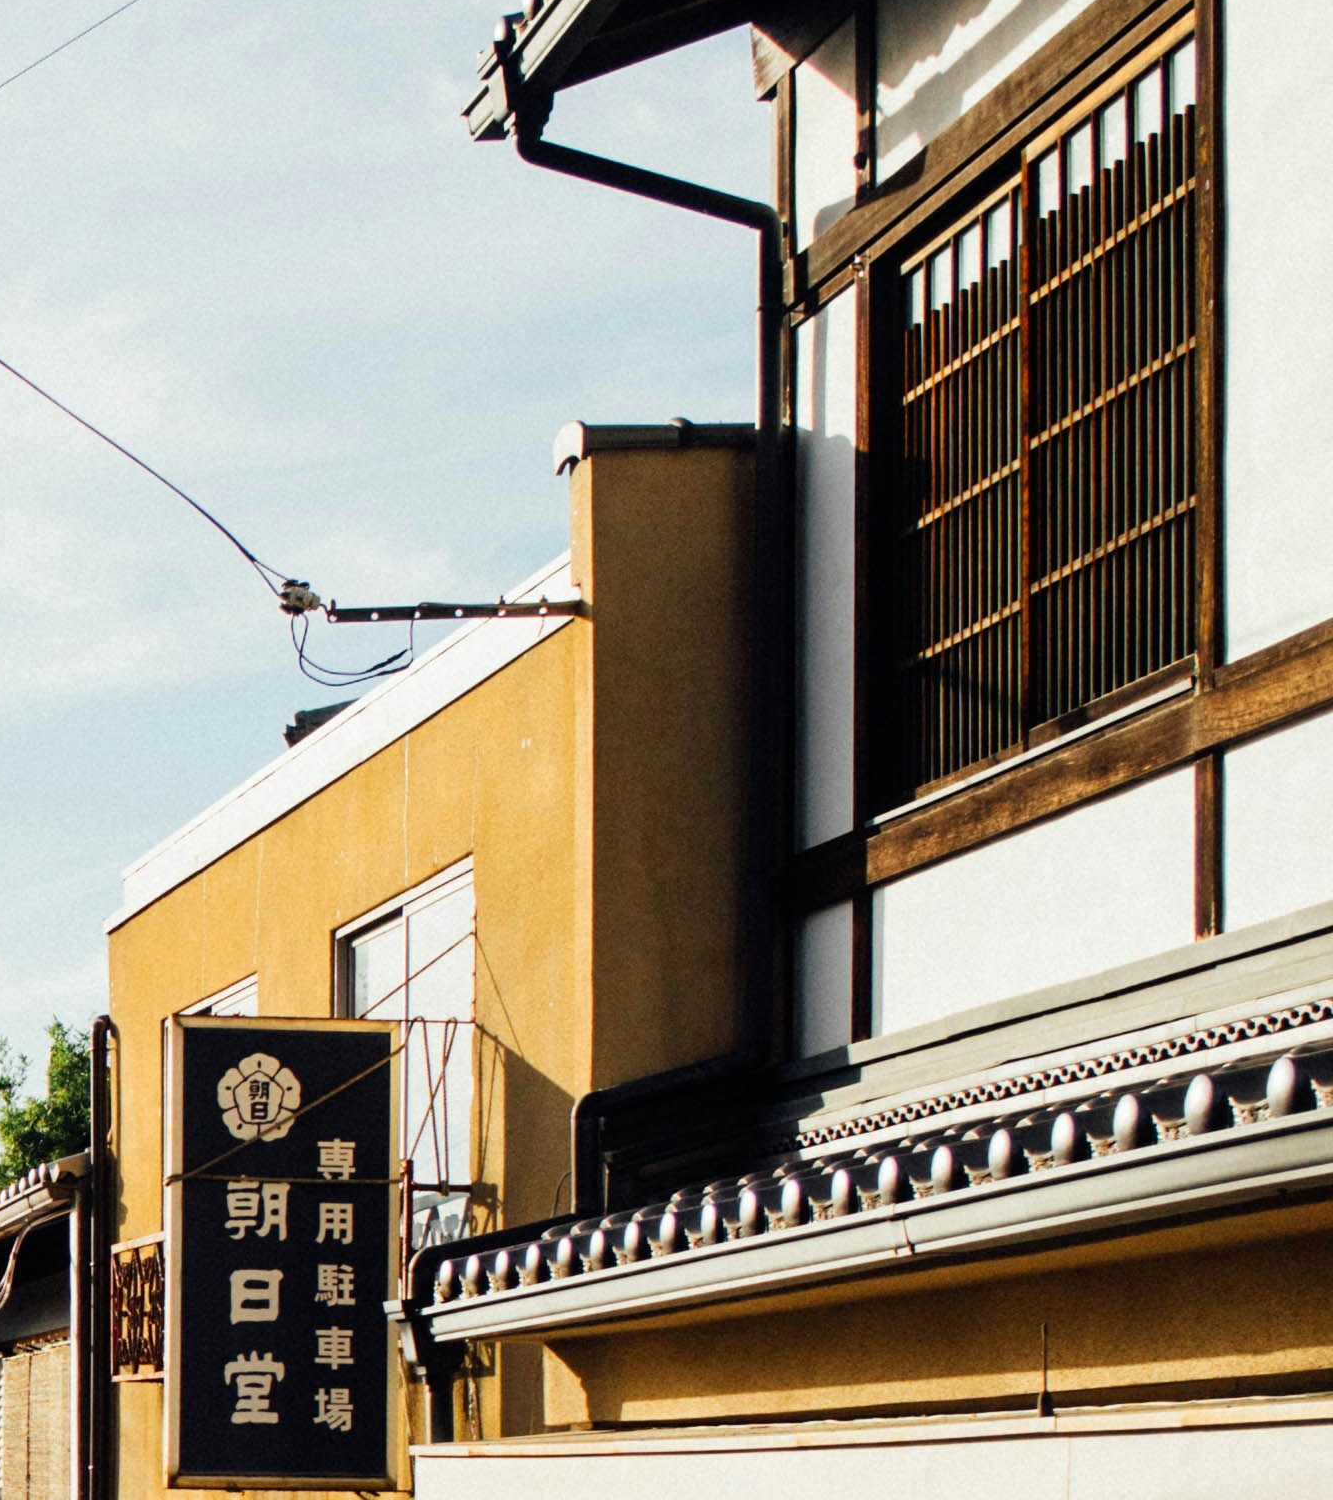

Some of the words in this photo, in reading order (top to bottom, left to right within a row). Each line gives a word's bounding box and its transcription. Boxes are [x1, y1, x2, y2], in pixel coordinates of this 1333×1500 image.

[249, 1080, 272, 1121] 朝日
[224, 1180, 290, 1426] 朝日堂
[313, 1138, 357, 1432] 専用駐車場
